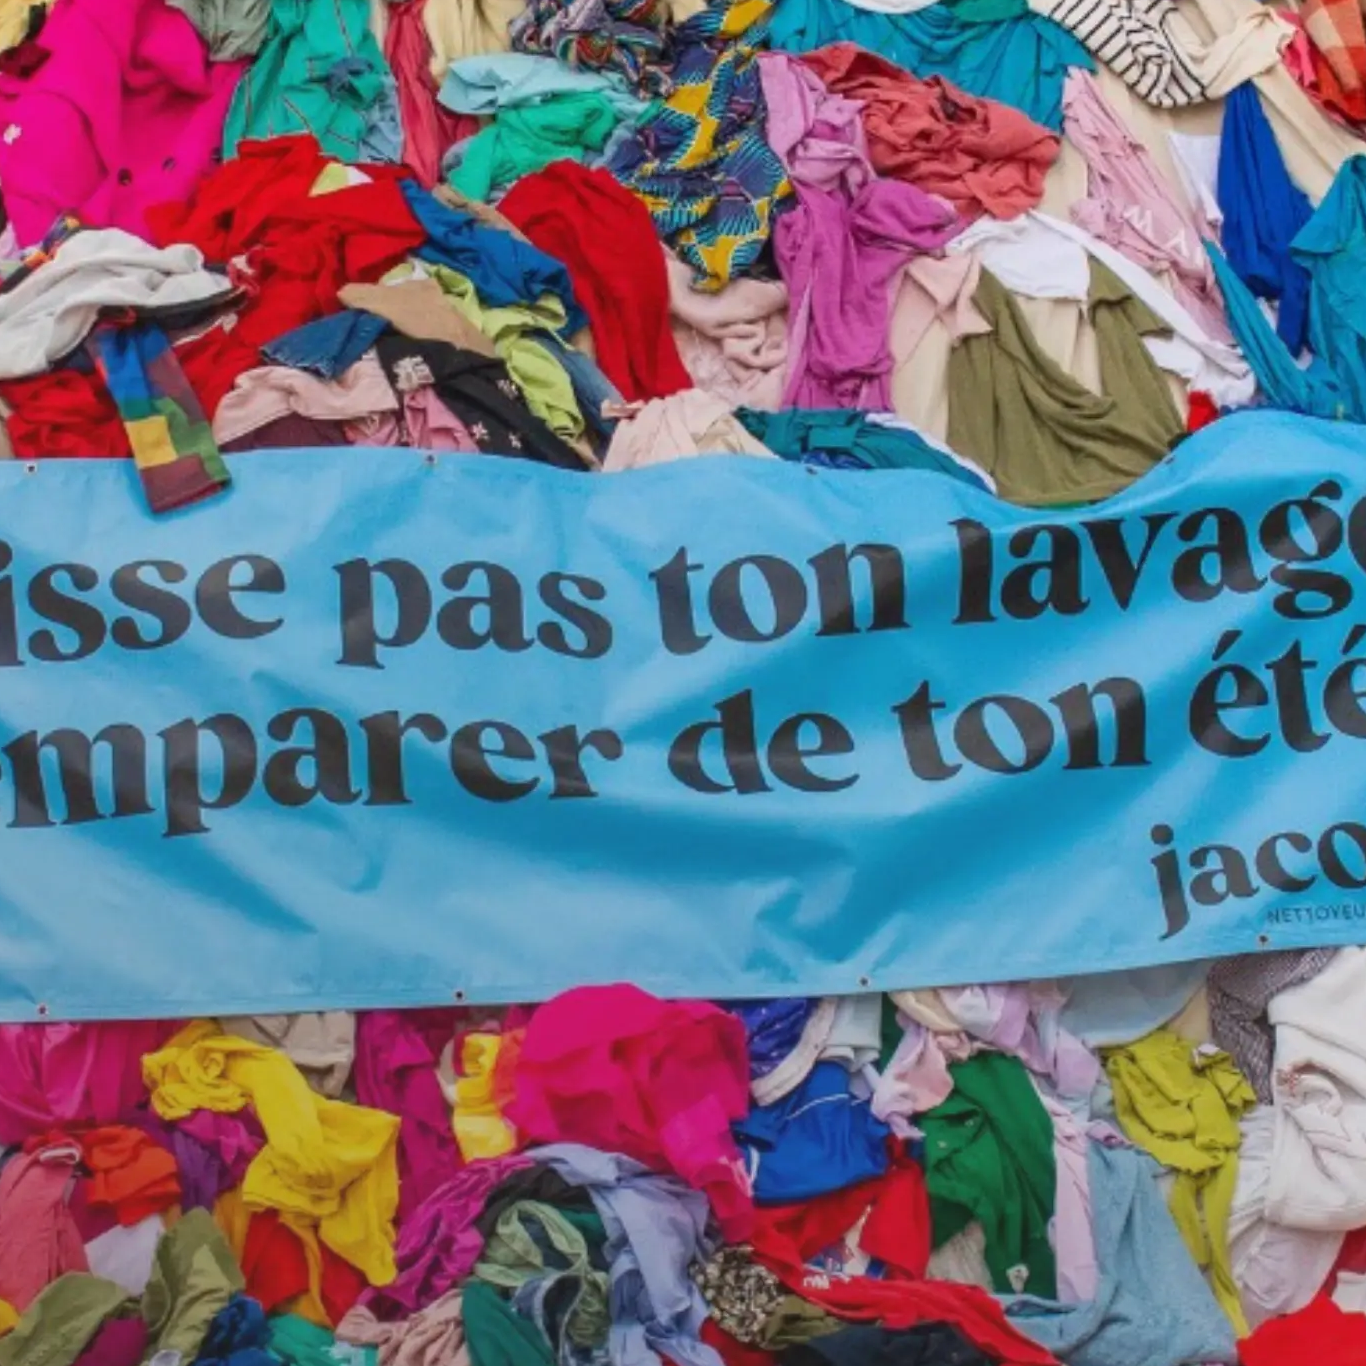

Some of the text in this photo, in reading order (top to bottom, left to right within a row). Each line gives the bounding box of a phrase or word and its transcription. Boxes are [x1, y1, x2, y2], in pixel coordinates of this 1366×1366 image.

[334, 558, 612, 668] pas
[649, 540, 910, 653] ton
[668, 688, 854, 794] de
[893, 677, 1149, 781] ton
